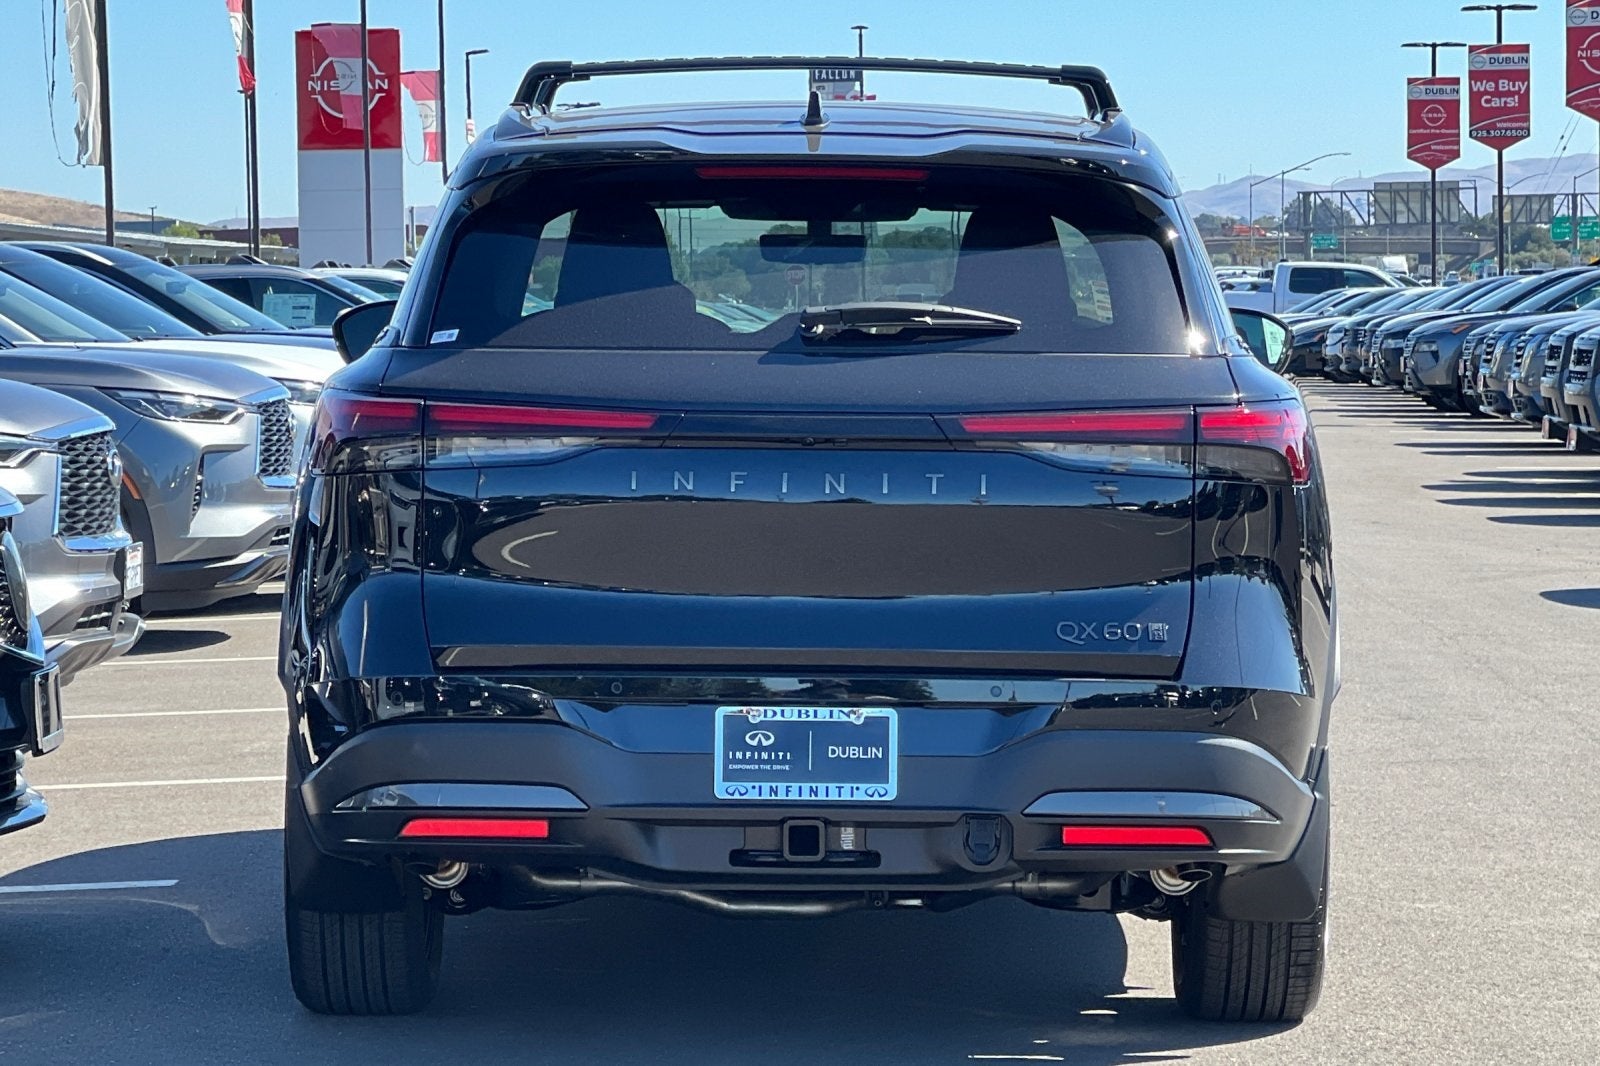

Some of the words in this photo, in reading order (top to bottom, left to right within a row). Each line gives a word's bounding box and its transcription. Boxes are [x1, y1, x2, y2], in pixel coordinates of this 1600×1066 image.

[1489, 56, 1529, 65] DUBLIN
[307, 78, 389, 91] NISN
[1425, 87, 1460, 95] DUBLIN
[1471, 80, 1496, 92] We
[1498, 79, 1528, 94] Buy
[1481, 95, 1519, 108] Cars!
[1471, 129, 1528, 137] 925.307.6500
[630, 470, 991, 496] INFINITI
[763, 708, 851, 719] DUBLIN
[729, 751, 791, 760] INFINITI
[827, 746, 883, 759] DUBLIN
[757, 784, 855, 799] INFINITI
